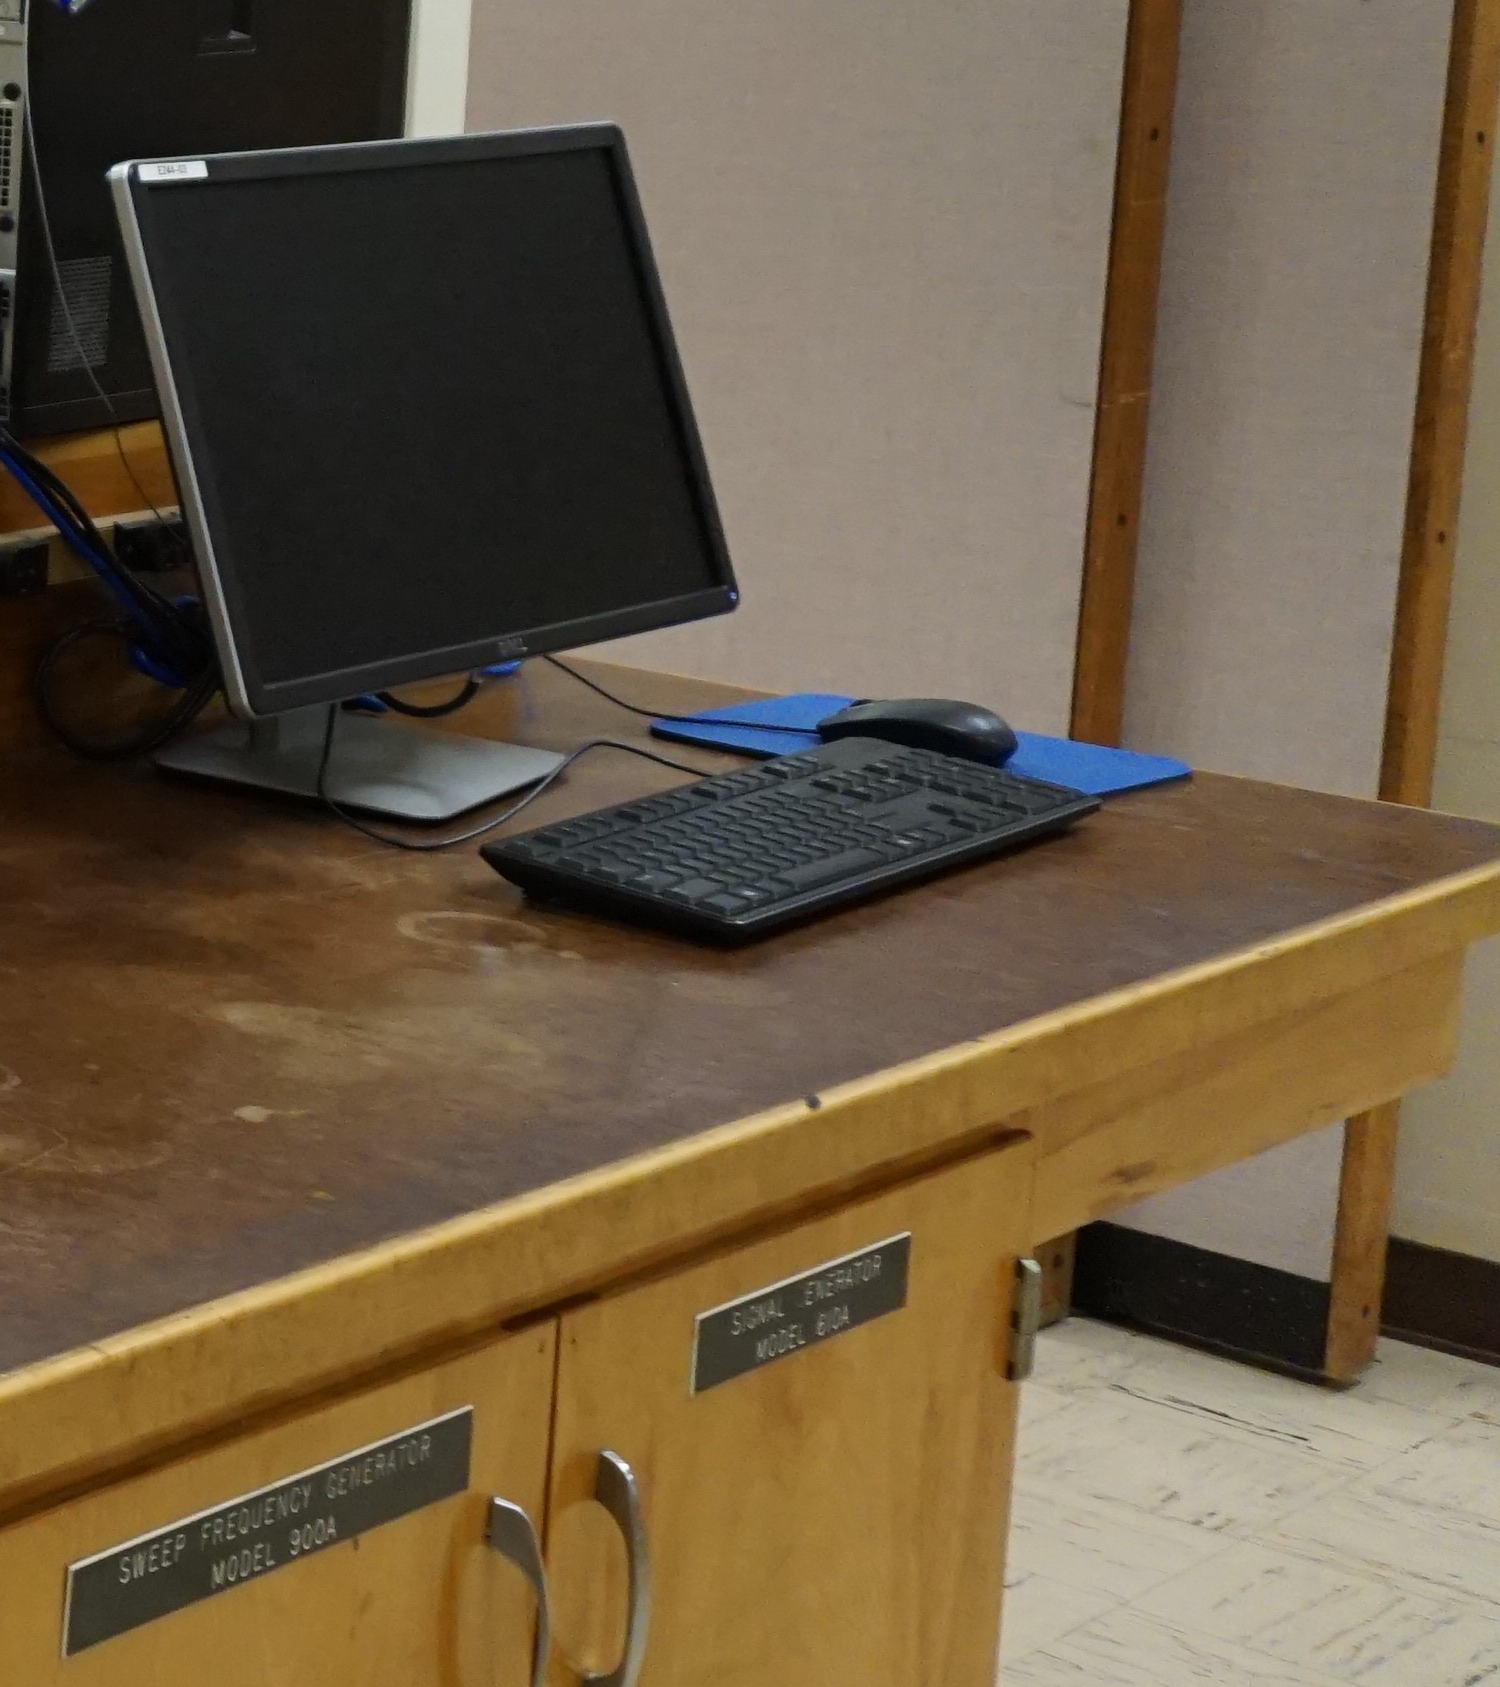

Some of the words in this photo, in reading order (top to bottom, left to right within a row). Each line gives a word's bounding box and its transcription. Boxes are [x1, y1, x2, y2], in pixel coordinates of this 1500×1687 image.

[731, 1296, 785, 1336] SIGNAL
[756, 1322, 806, 1362] MODEL
[816, 1304, 850, 1336] 610A
[118, 1533, 187, 1585] SWEEP
[200, 1482, 312, 1550] FREQUENCY
[325, 1434, 431, 1500] GENERATOR
[211, 1541, 276, 1590] MODEL
[289, 1515, 338, 1557] 900A
